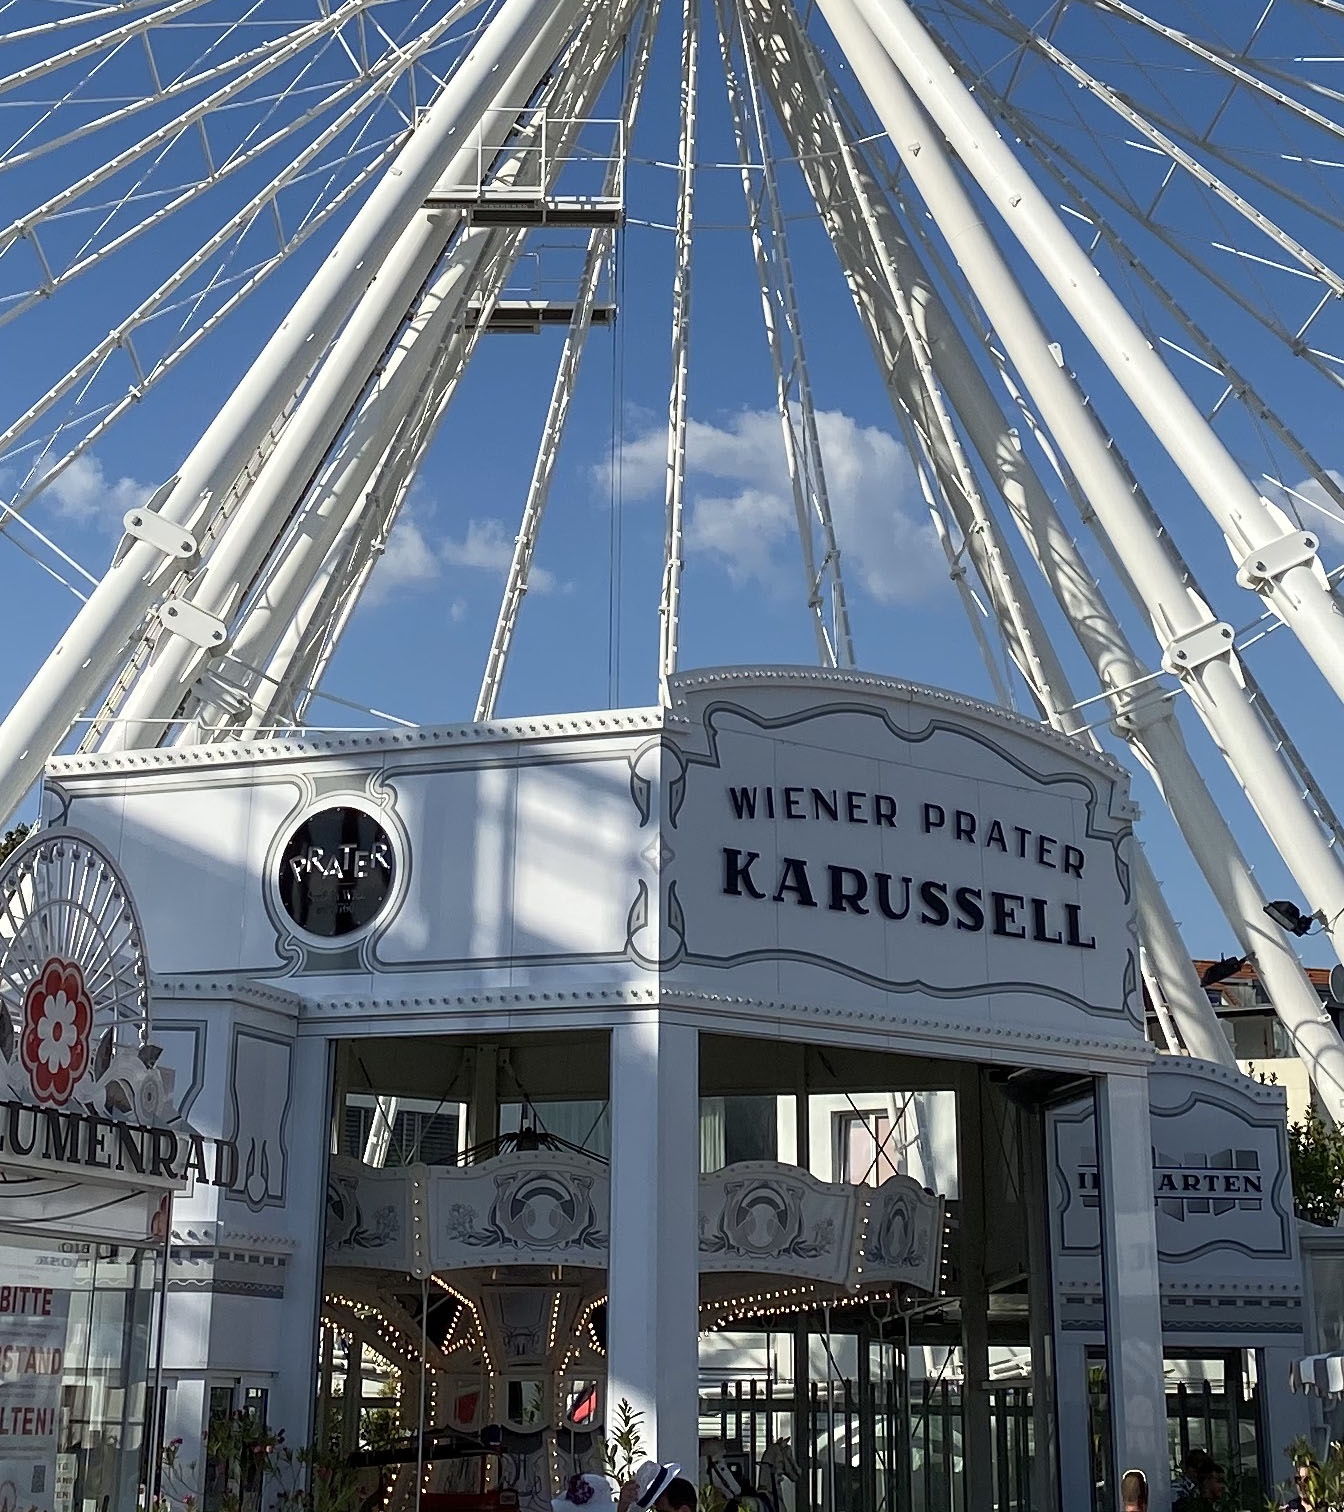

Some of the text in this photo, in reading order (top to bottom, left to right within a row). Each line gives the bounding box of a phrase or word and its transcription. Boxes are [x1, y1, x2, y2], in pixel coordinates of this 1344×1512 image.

[289, 843, 391, 882] PRATER
[729, 786, 1086, 879] WIENER PRATER
[722, 847, 1097, 950] KARUSSELL
[0, 1286, 54, 1316] BITTE
